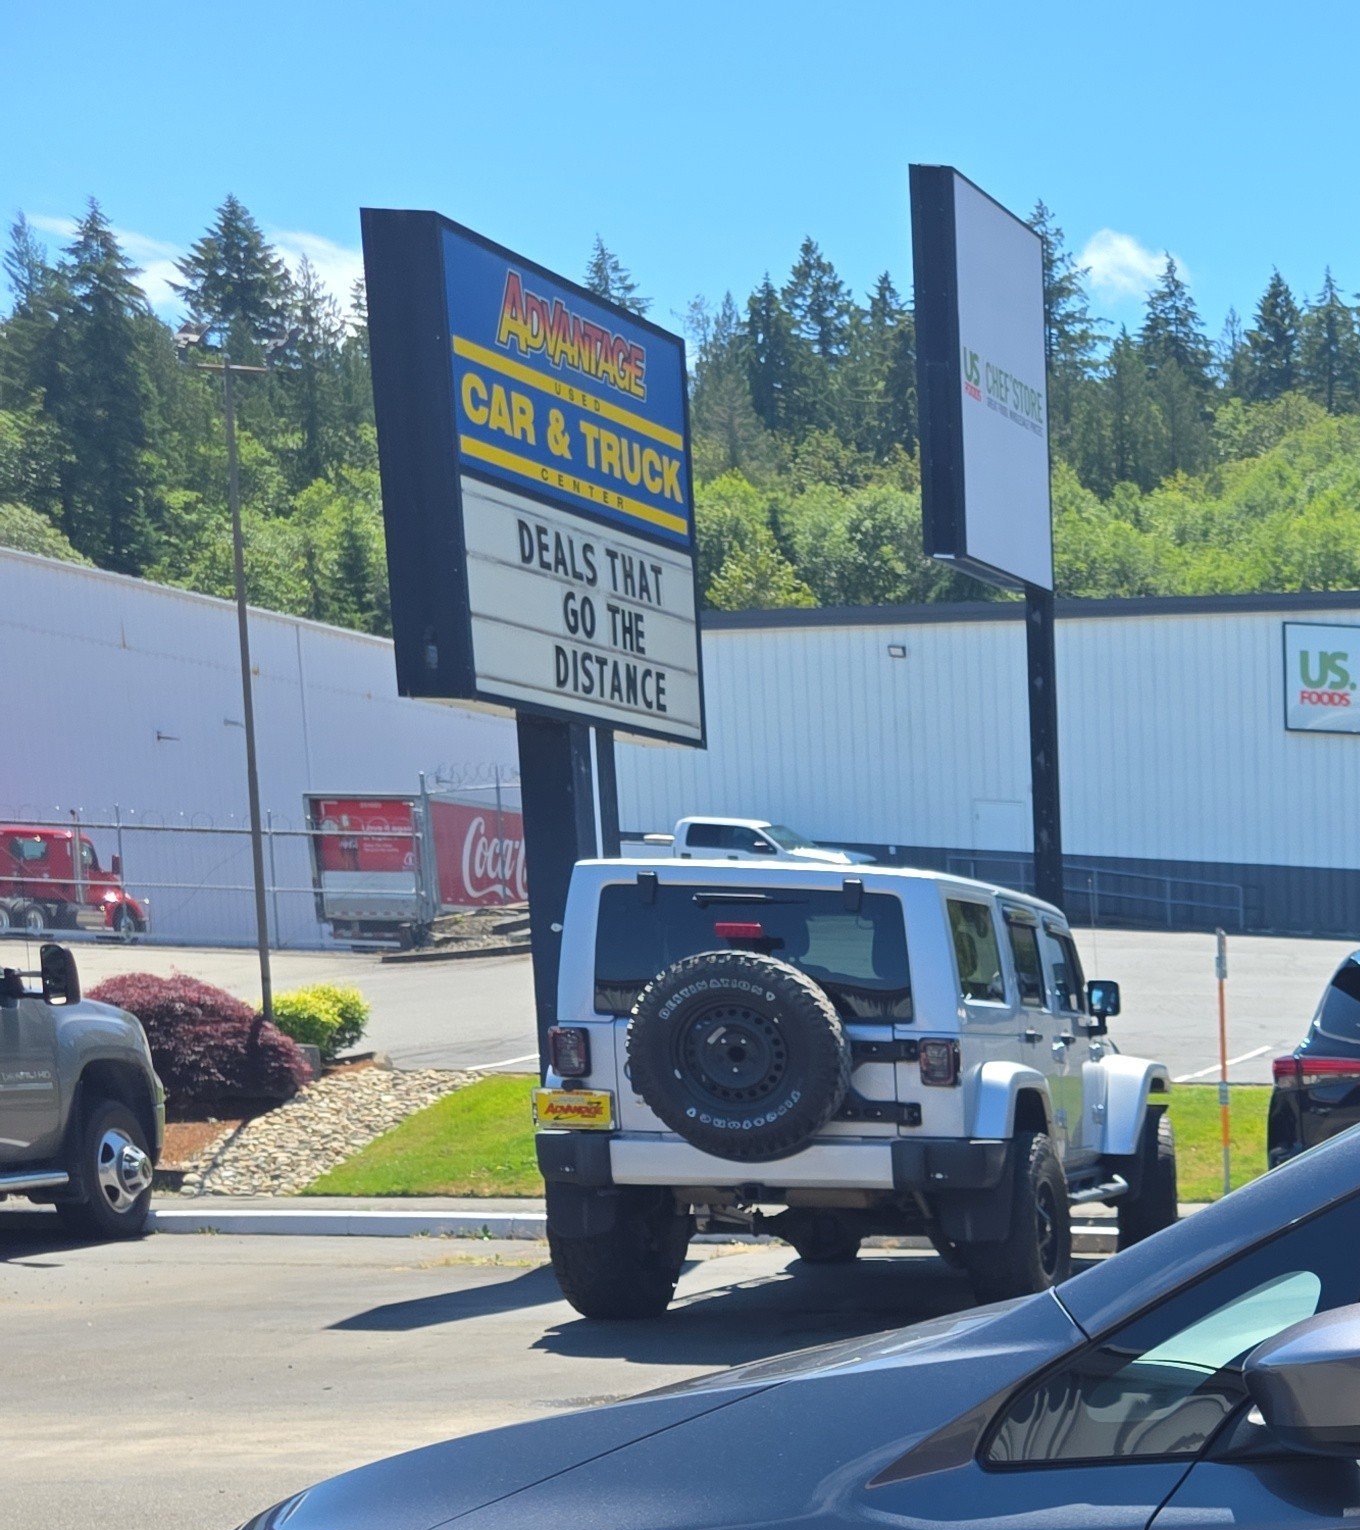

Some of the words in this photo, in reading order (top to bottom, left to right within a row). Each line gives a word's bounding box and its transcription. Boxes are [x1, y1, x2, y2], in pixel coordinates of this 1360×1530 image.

[496, 268, 647, 402] ADVANTAGE
[554, 382, 601, 412] USED
[985, 361, 1043, 425] CHEF'STORE
[461, 372, 536, 446] CAR
[547, 409, 572, 460] &
[580, 419, 683, 504] TRUCK
[541, 468, 625, 509] CENTER
[517, 518, 598, 587] DEALS
[605, 547, 663, 606] THAT
[563, 591, 596, 640] GO
[606, 602, 646, 655] THE
[554, 645, 668, 713] DISTANCE
[1299, 690, 1351, 707] FOODS
